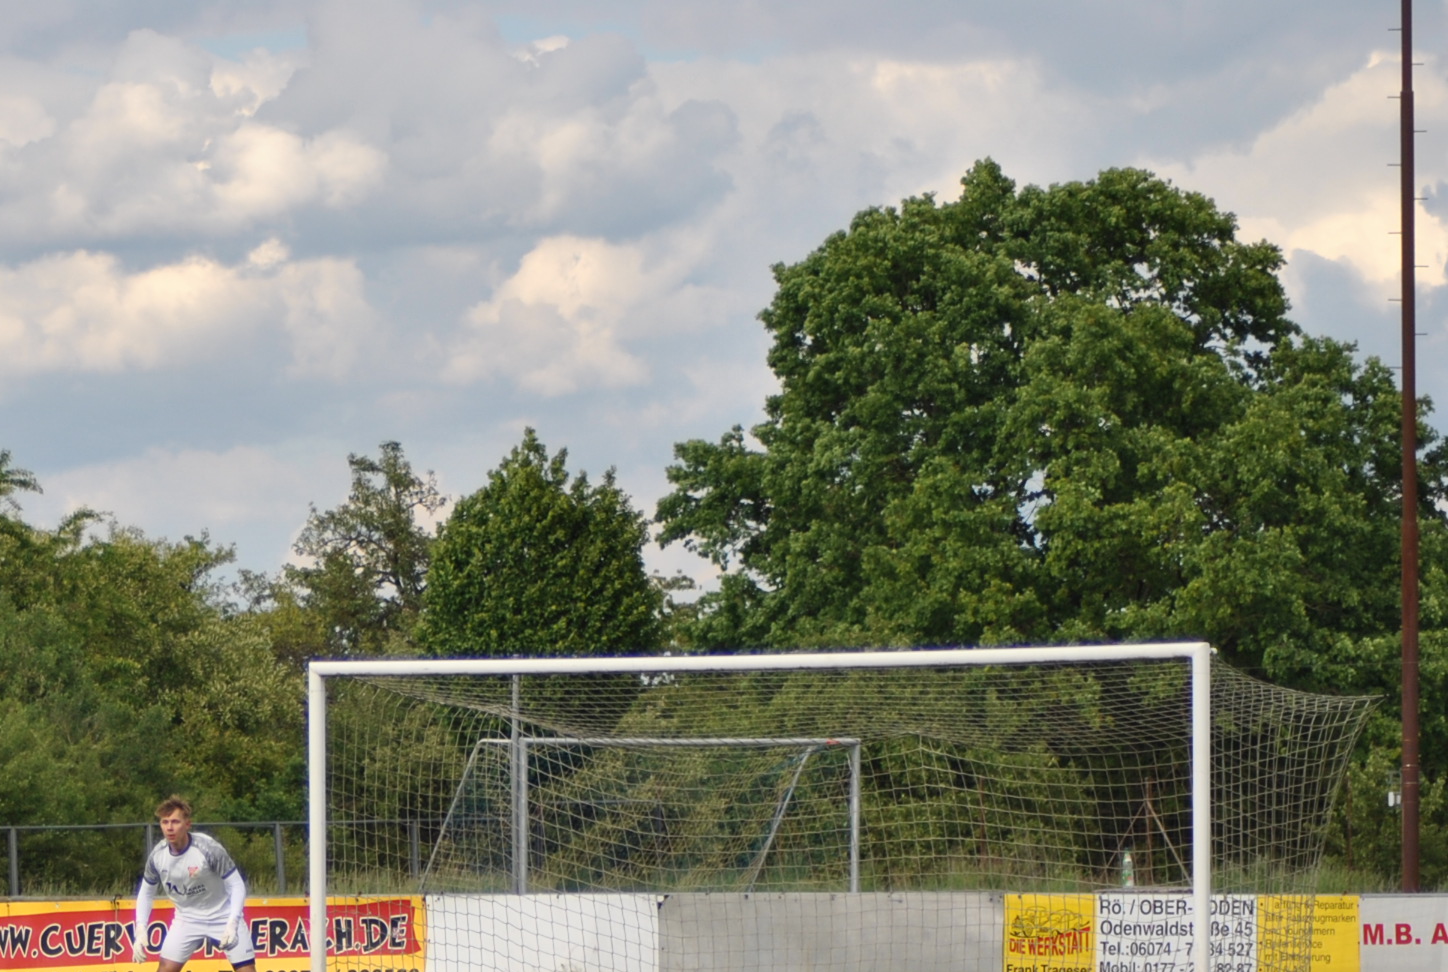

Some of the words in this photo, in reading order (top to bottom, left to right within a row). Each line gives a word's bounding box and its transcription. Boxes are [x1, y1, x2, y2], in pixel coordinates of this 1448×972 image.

[1140, 899, 1253, 915] OBER-ODEN
[1313, 901, 1354, 911] Reparatur
[1100, 920, 1230, 936] Odenwaldstße
[1235, 921, 1252, 937] 45
[1363, 923, 1421, 945] M.B.
[1009, 938, 1026, 955] DIE
[1228, 942, 1253, 956] 527
